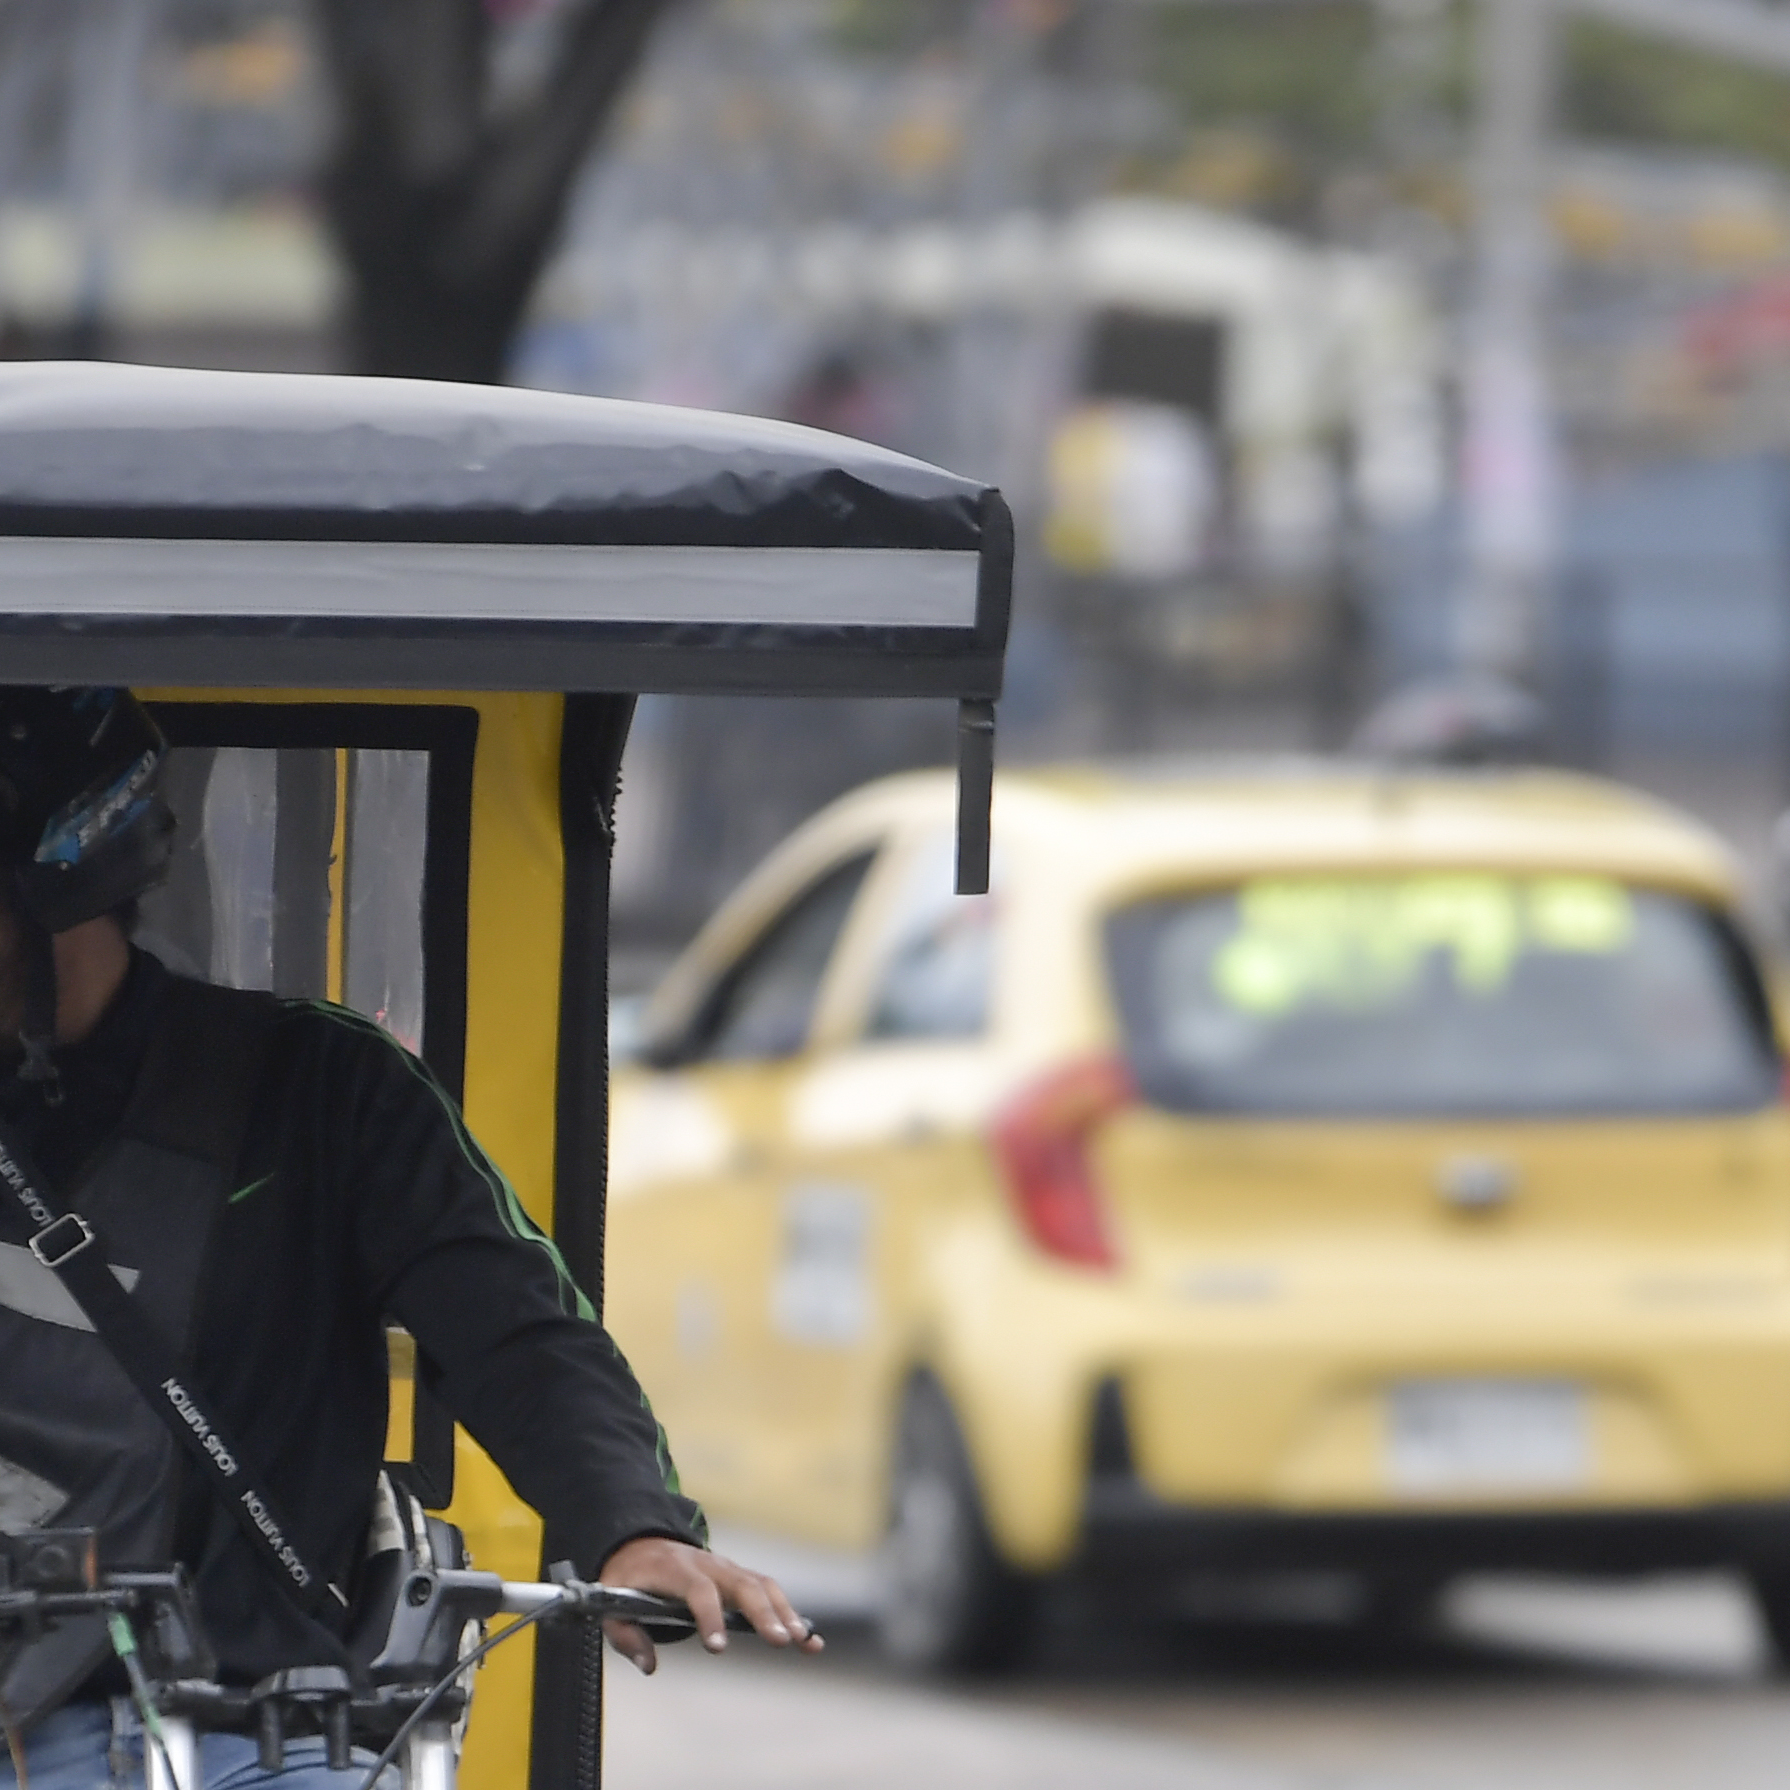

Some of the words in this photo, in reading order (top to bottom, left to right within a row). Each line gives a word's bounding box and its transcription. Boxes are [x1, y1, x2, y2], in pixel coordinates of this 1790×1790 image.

[17, 1187, 55, 1226] LOUIS
[161, 1378, 211, 1440] VUITTON
[202, 1434, 238, 1477] LOUIS
[240, 1490, 284, 1550] VUITTON
[278, 1546, 310, 1588] LOUIS
